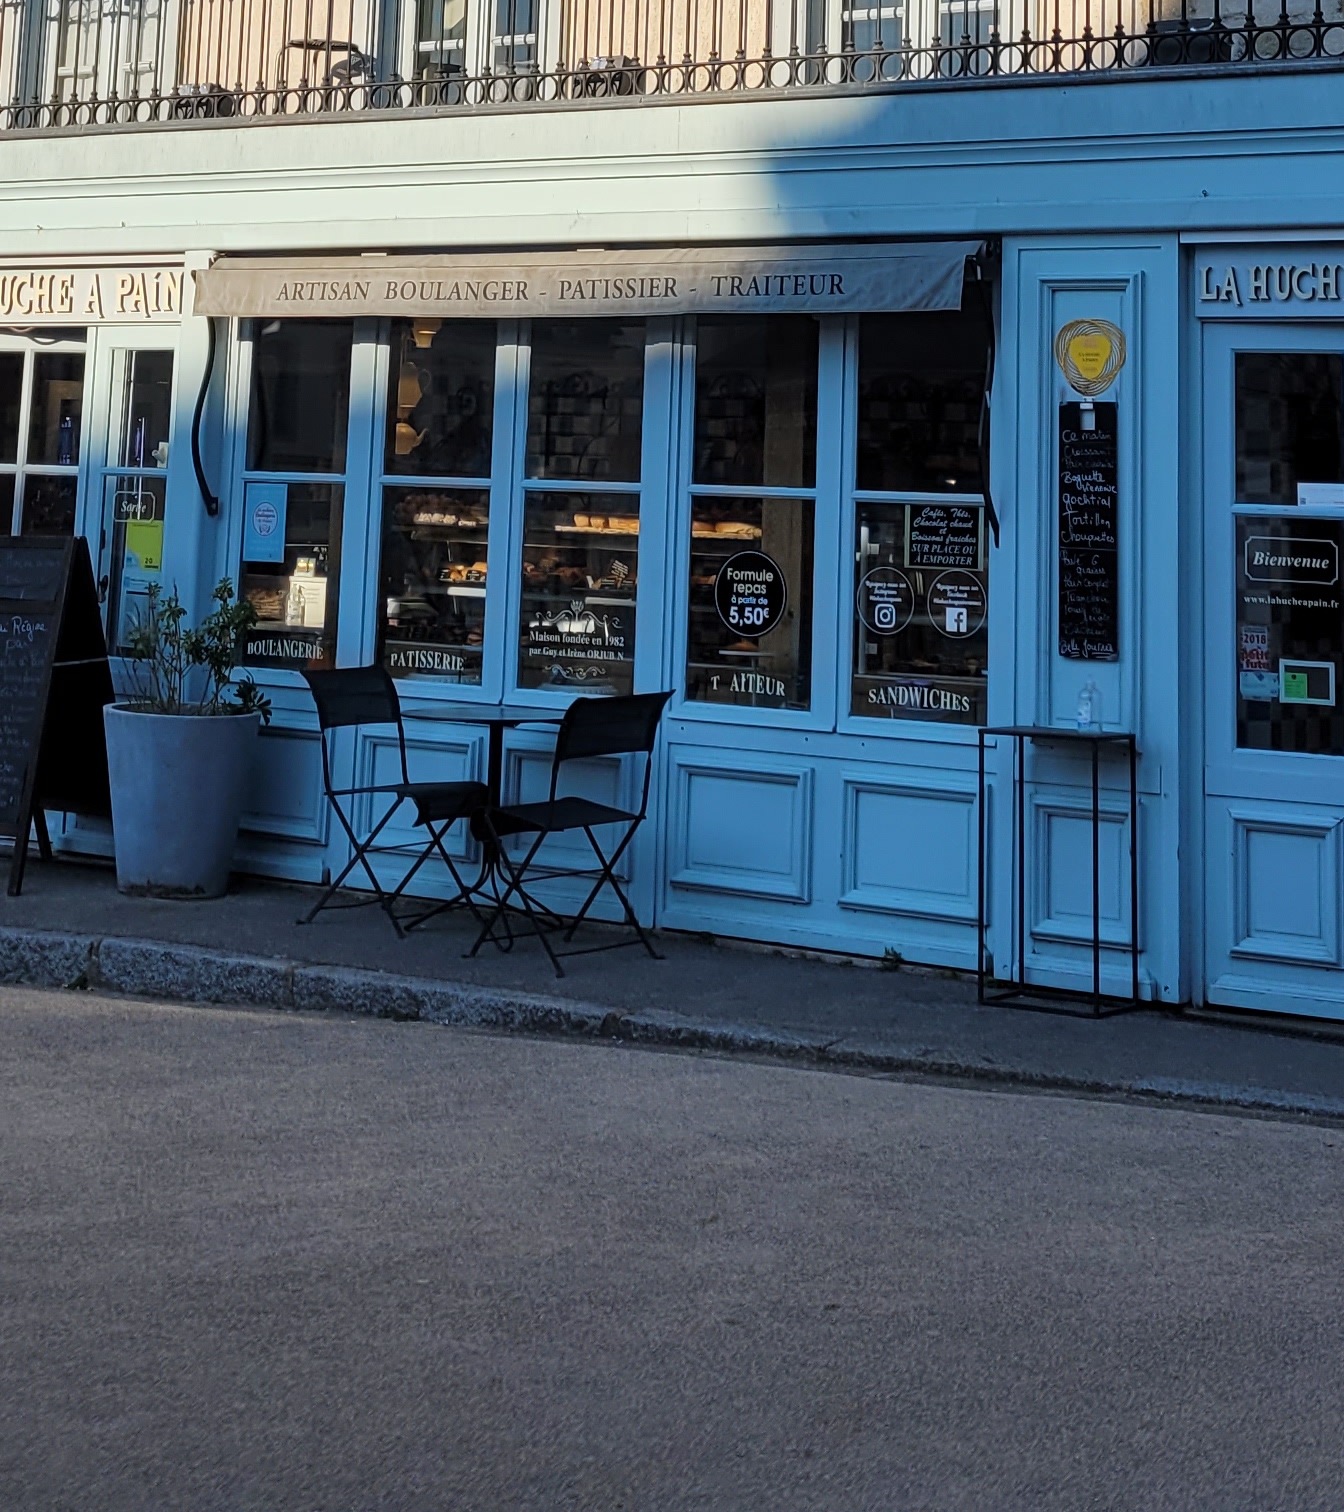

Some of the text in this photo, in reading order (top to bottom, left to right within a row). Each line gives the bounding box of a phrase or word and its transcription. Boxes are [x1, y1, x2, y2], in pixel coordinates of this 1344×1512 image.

[276, 280, 371, 301] ARTISAN
[384, 280, 529, 301] BOULANGER
[558, 277, 678, 300] PATISSIER
[710, 274, 845, 298] TRAITEUR
[1199, 266, 1243, 307] LA
[84, 273, 105, 319] A
[911, 543, 976, 555] SUR PLACE OU
[922, 554, 973, 565] EMPORTER
[1253, 551, 1329, 569] Bienvenue
[727, 568, 774, 582] Formule
[733, 582, 767, 595] repas
[1243, 595, 1339, 608] www.lahucheapain.fr
[729, 606, 770, 627] 5,50€
[529, 631, 625, 647] Maison fondée en 1982
[1244, 633, 1266, 644] 2018
[529, 648, 541, 657] par
[247, 638, 970, 712] BOULANGERIE PATISSERIE TAITEUR SANDWICHES
